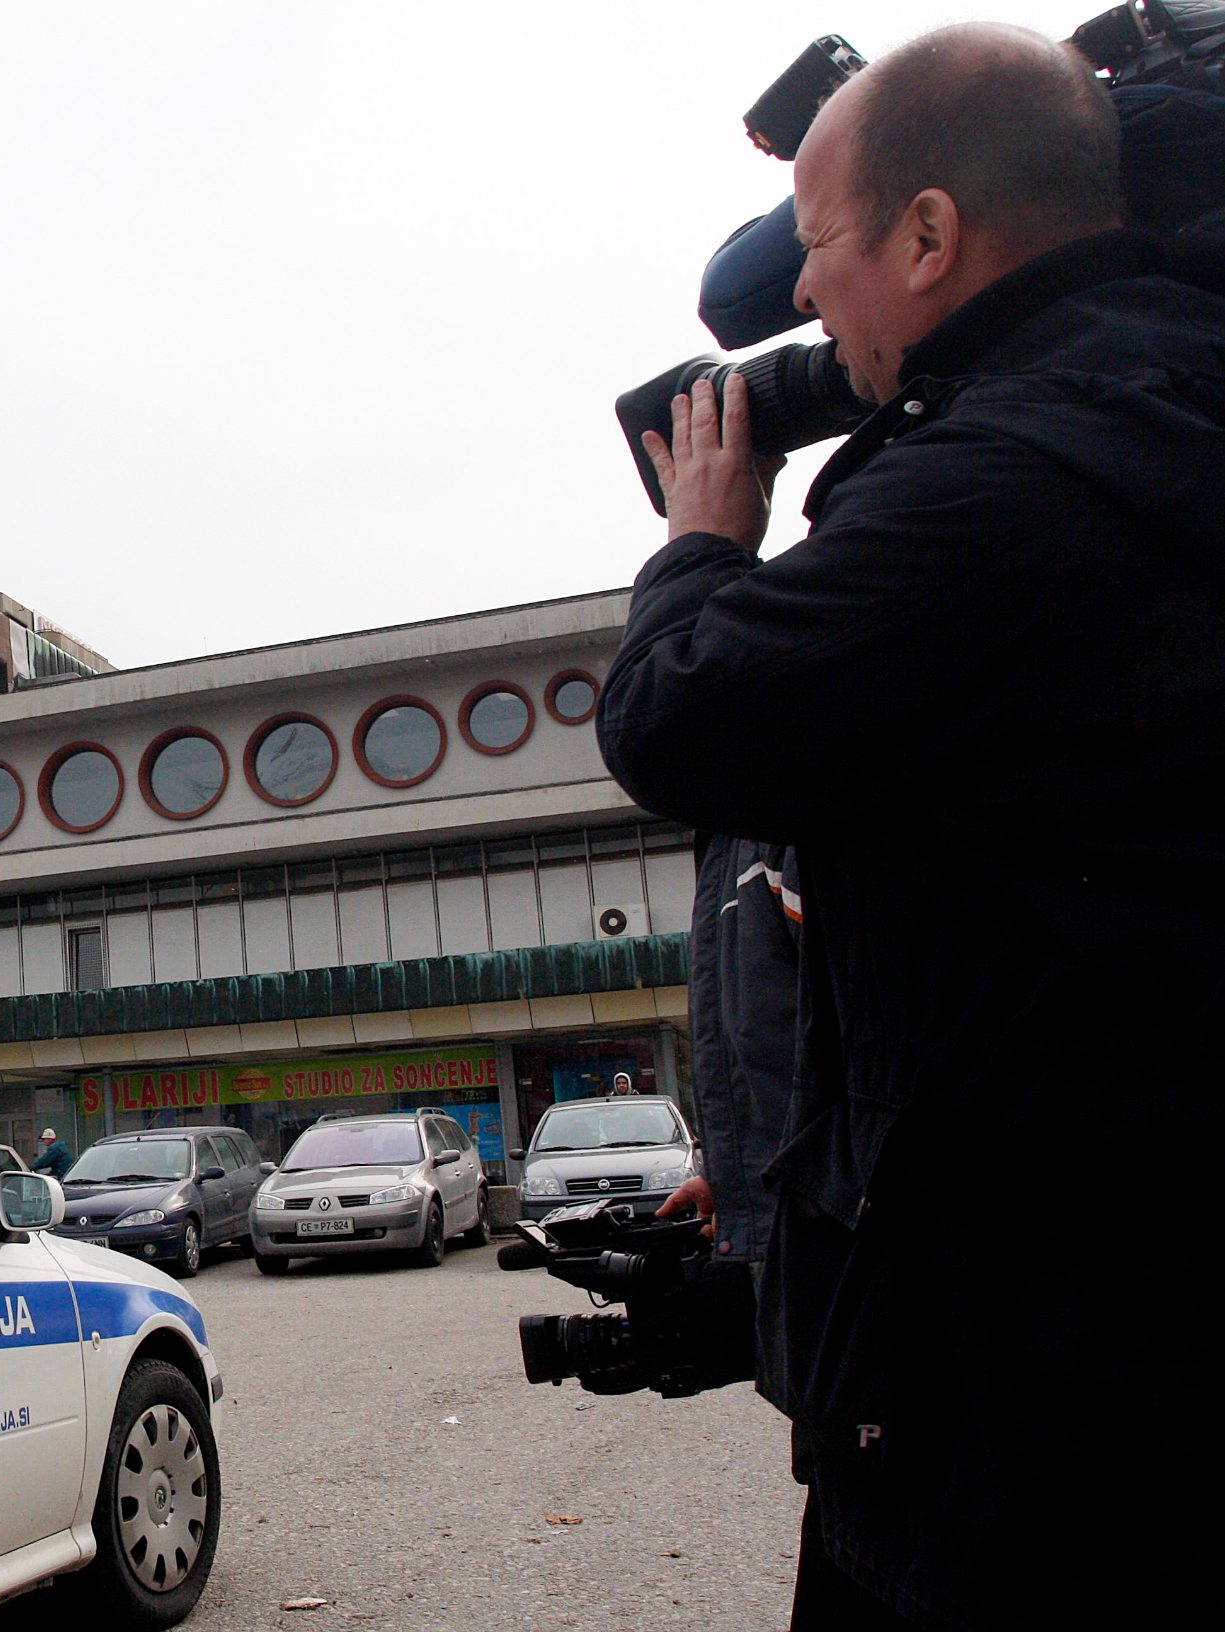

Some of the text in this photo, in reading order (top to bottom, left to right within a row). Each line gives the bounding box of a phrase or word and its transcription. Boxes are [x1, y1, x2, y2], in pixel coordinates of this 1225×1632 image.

[283, 1053, 499, 1099] STUDIO ZA SONČENJE
[300, 1222, 312, 1232] CE
[856, 1424, 882, 1448] P
